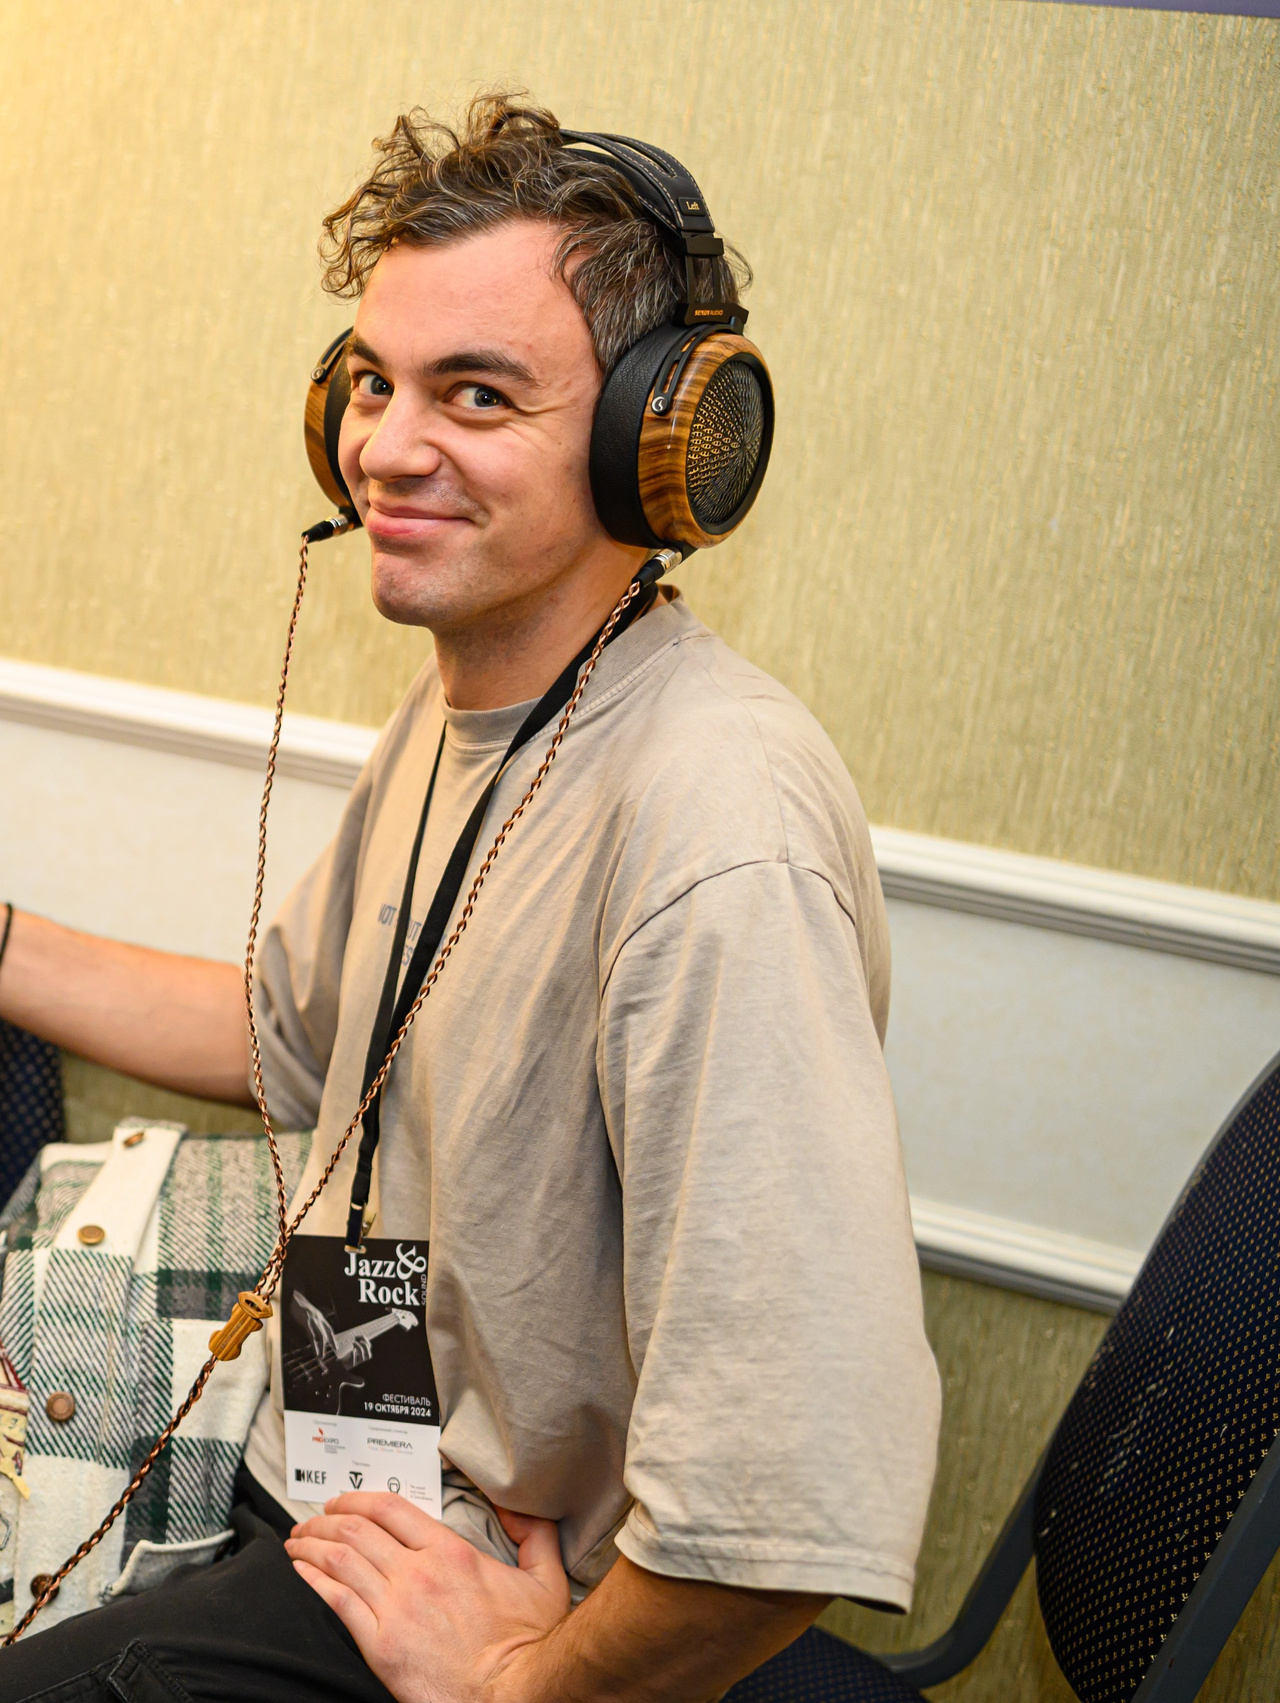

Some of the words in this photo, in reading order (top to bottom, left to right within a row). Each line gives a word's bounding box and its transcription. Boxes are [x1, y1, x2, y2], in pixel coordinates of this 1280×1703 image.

[686, 201, 700, 210] Left
[358, 1278, 421, 1306] Rock
[382, 1393, 432, 1406] ФЕСТИВАЛЬ
[364, 1401, 374, 1411] 19
[375, 1402, 409, 1415] ОКТЯБРЯ
[410, 1406, 432, 1417] 2024
[306, 1470, 327, 1485] KEF
